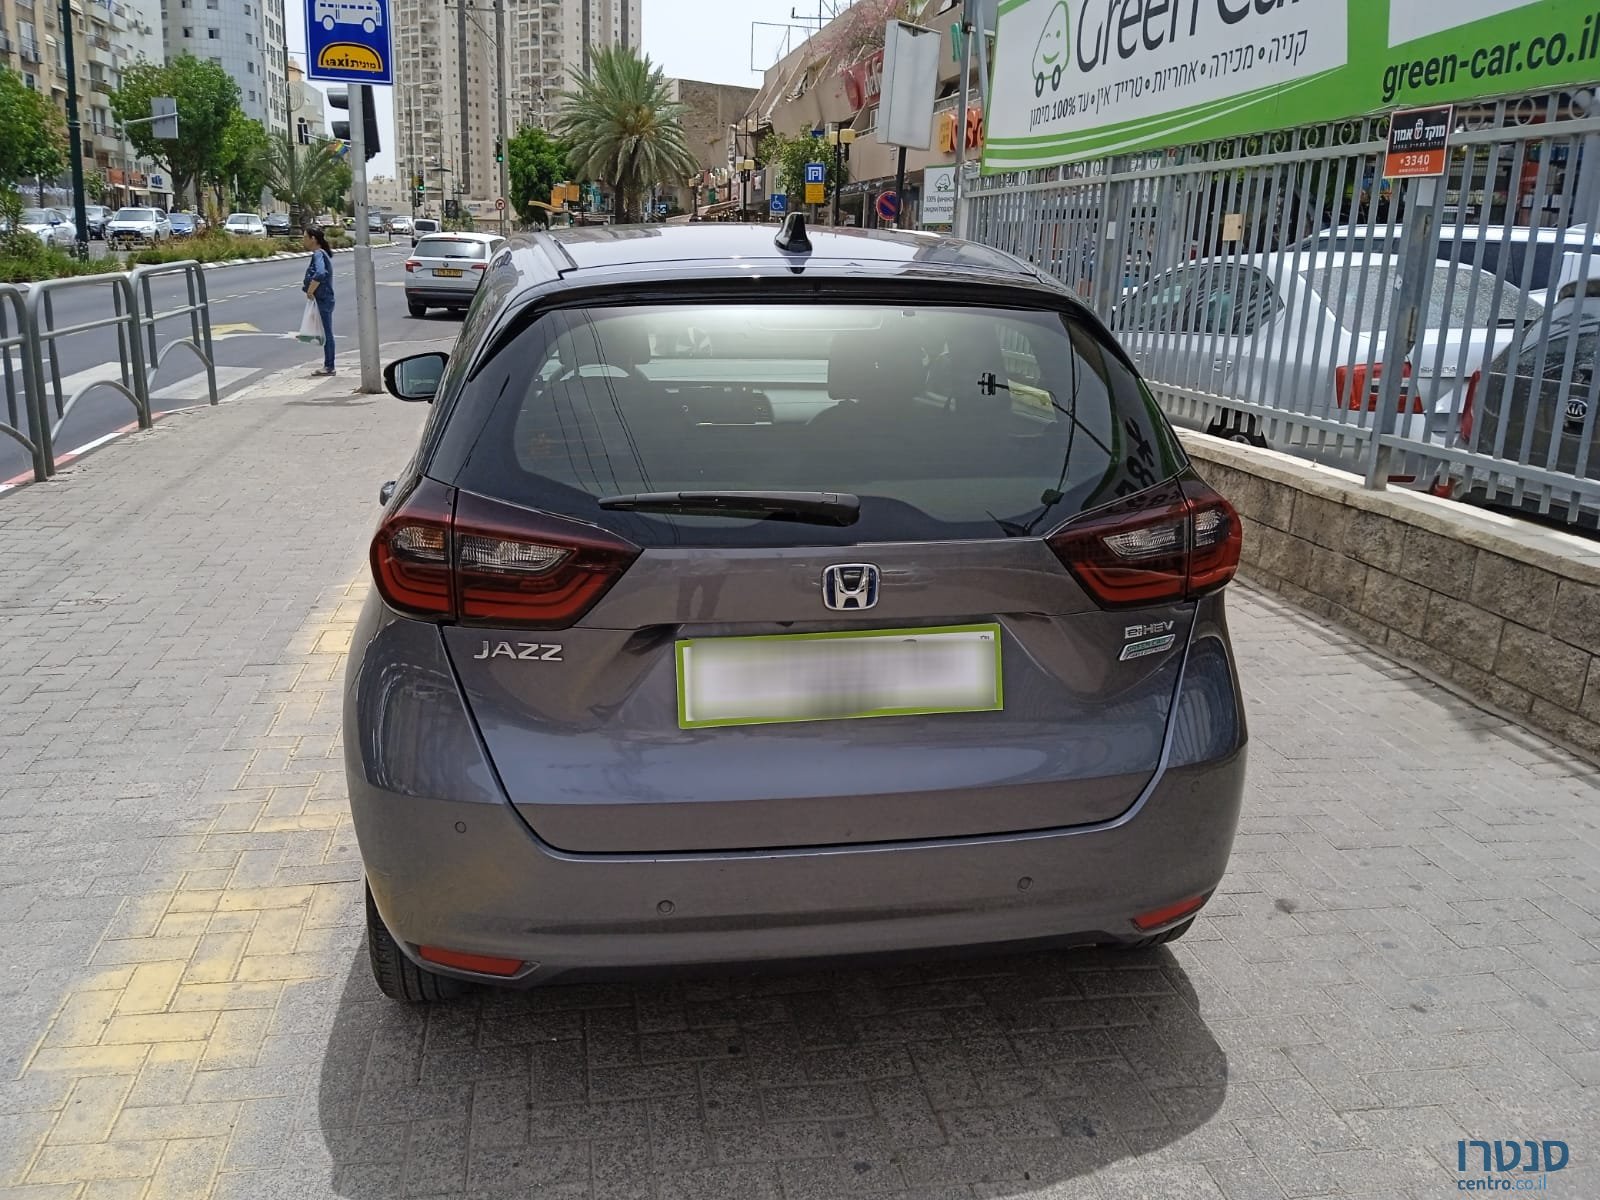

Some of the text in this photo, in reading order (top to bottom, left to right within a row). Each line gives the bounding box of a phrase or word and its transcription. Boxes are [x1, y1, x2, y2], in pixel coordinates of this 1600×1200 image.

[325, 53, 349, 67] taxi
[350, 59, 377, 69] מונית
[1382, 12, 1600, 102] green-car.co.il
[1029, 30, 1309, 132] קניה מכירה אחריות טרייד אין עד 100% מימון
[1393, 125, 1446, 145] מוקד אמון
[473, 640, 563, 661] JAZZ
